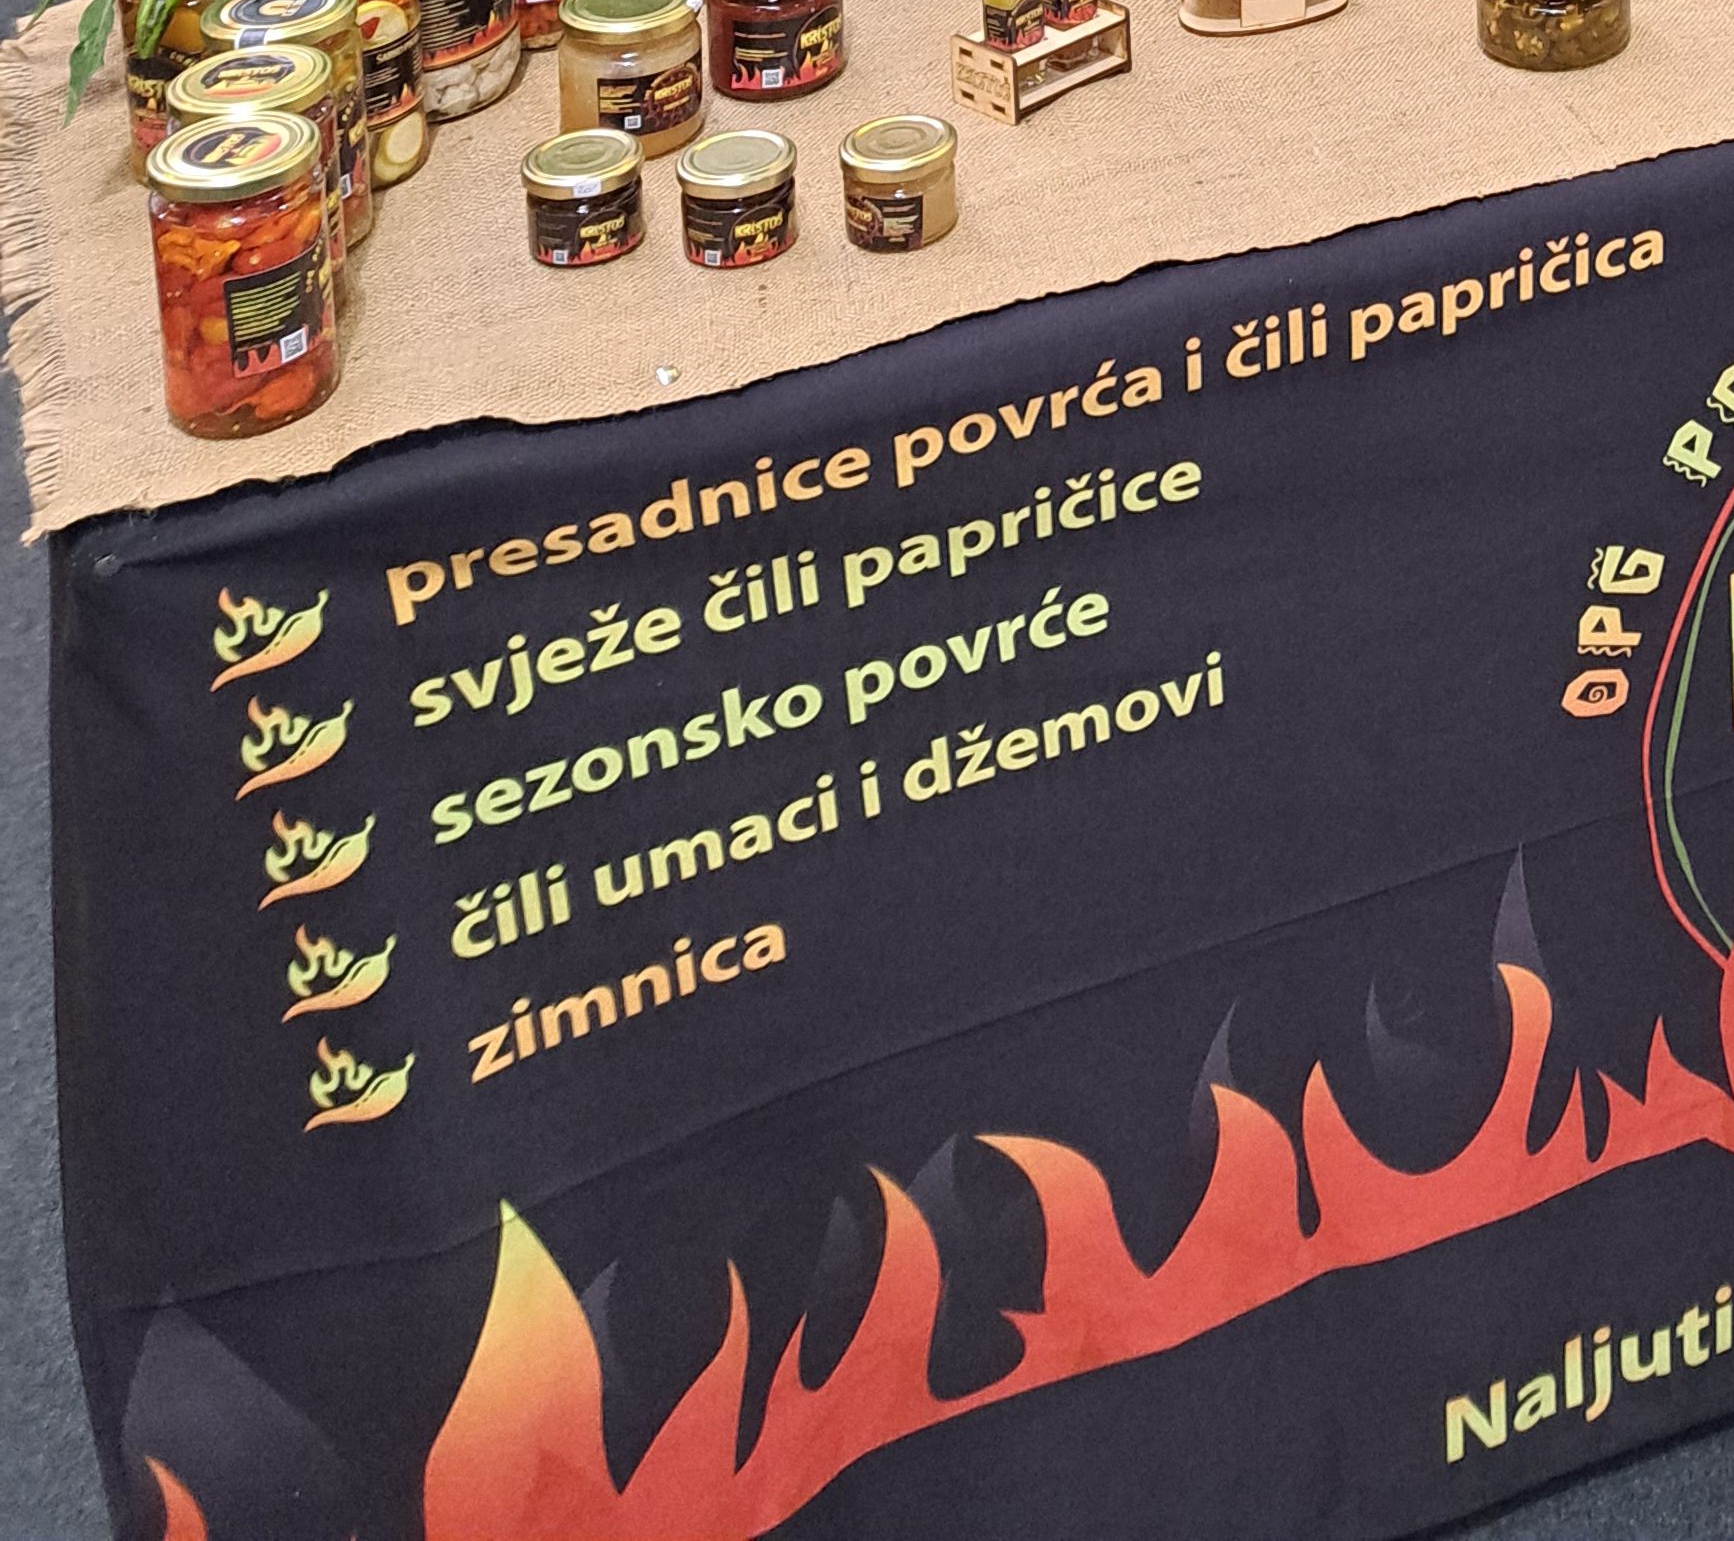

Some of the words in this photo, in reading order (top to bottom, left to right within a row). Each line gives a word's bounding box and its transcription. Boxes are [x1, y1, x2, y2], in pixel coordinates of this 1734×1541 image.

[385, 445, 872, 626] presadnice
[892, 358, 1163, 488] povrća
[1184, 338, 1203, 392] i
[1224, 303, 1328, 380] čili
[1347, 227, 1666, 361] papričica
[408, 601, 682, 728] svježe
[703, 549, 820, 633] čili
[841, 459, 1203, 609] papričice
[430, 682, 823, 845] sezonsko
[843, 586, 1110, 725] povrće
[1560, 544, 1667, 717] OPG
[450, 862, 571, 960] čili
[593, 772, 840, 907] umaci
[860, 760, 883, 820] i
[901, 650, 1226, 804] džemovi
[465, 922, 787, 1085] zimnica
